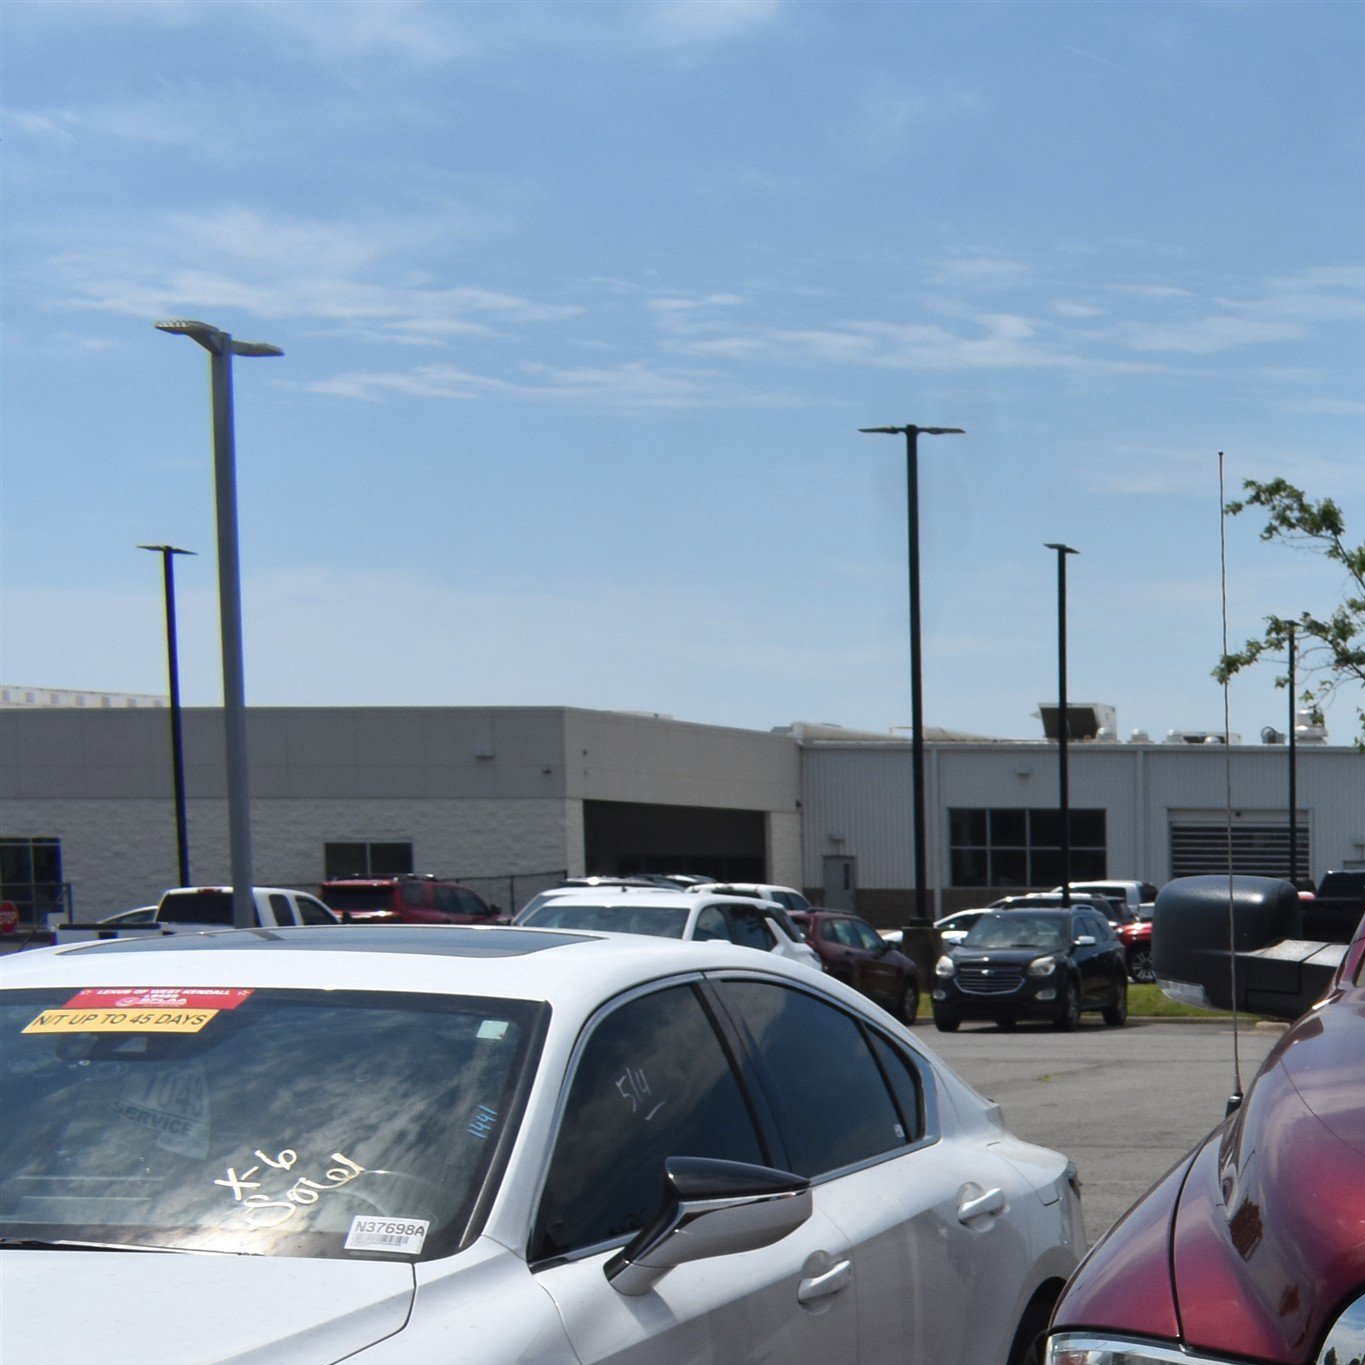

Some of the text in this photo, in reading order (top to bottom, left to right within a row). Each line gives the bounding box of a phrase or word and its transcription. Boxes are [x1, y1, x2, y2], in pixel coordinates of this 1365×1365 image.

[33, 1014, 208, 1026] N/T UP TO 45 DAYS
[111, 1101, 194, 1136] SERVICE
[355, 1221, 425, 1237] N37698A
